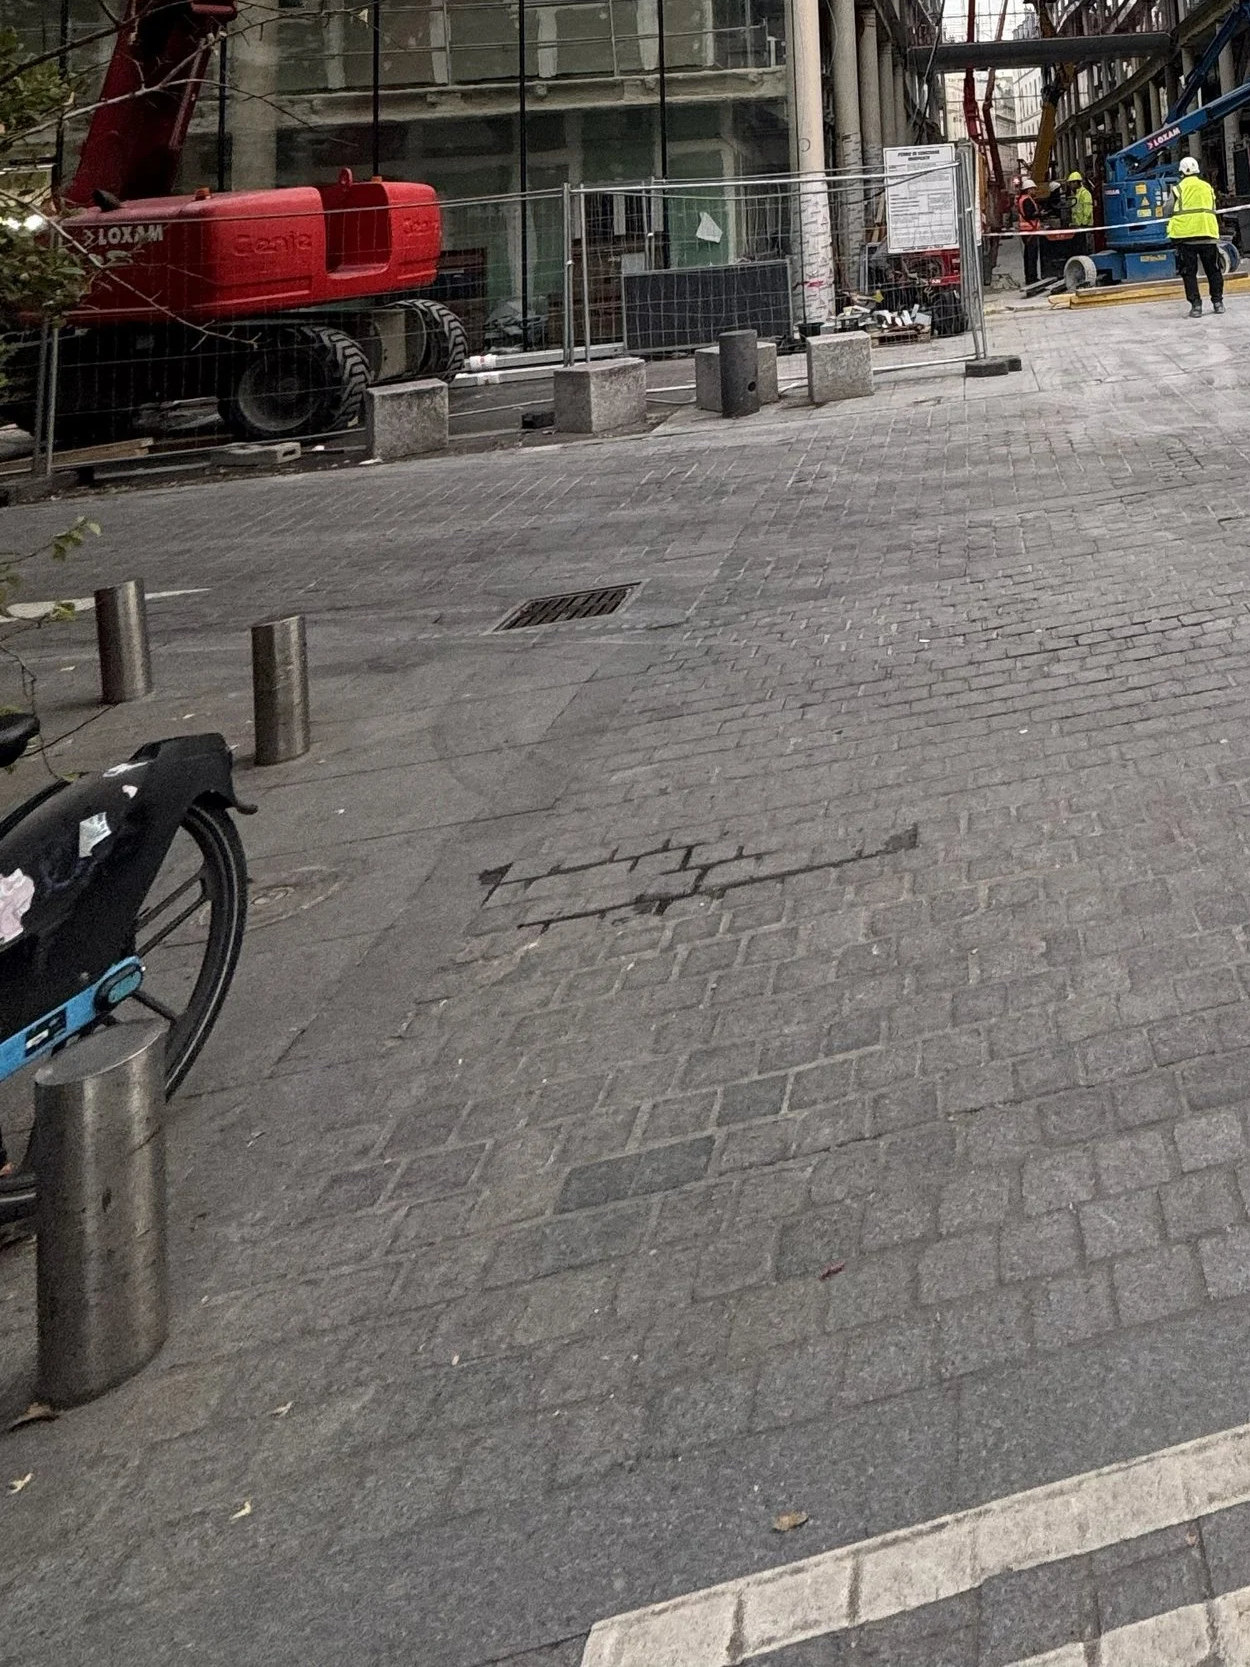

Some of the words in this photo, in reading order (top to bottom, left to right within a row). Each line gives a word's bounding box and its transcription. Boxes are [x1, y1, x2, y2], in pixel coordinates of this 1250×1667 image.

[1153, 127, 1181, 147] LOXAM
[98, 224, 164, 246] LOXAM
[233, 230, 313, 257] Genie
